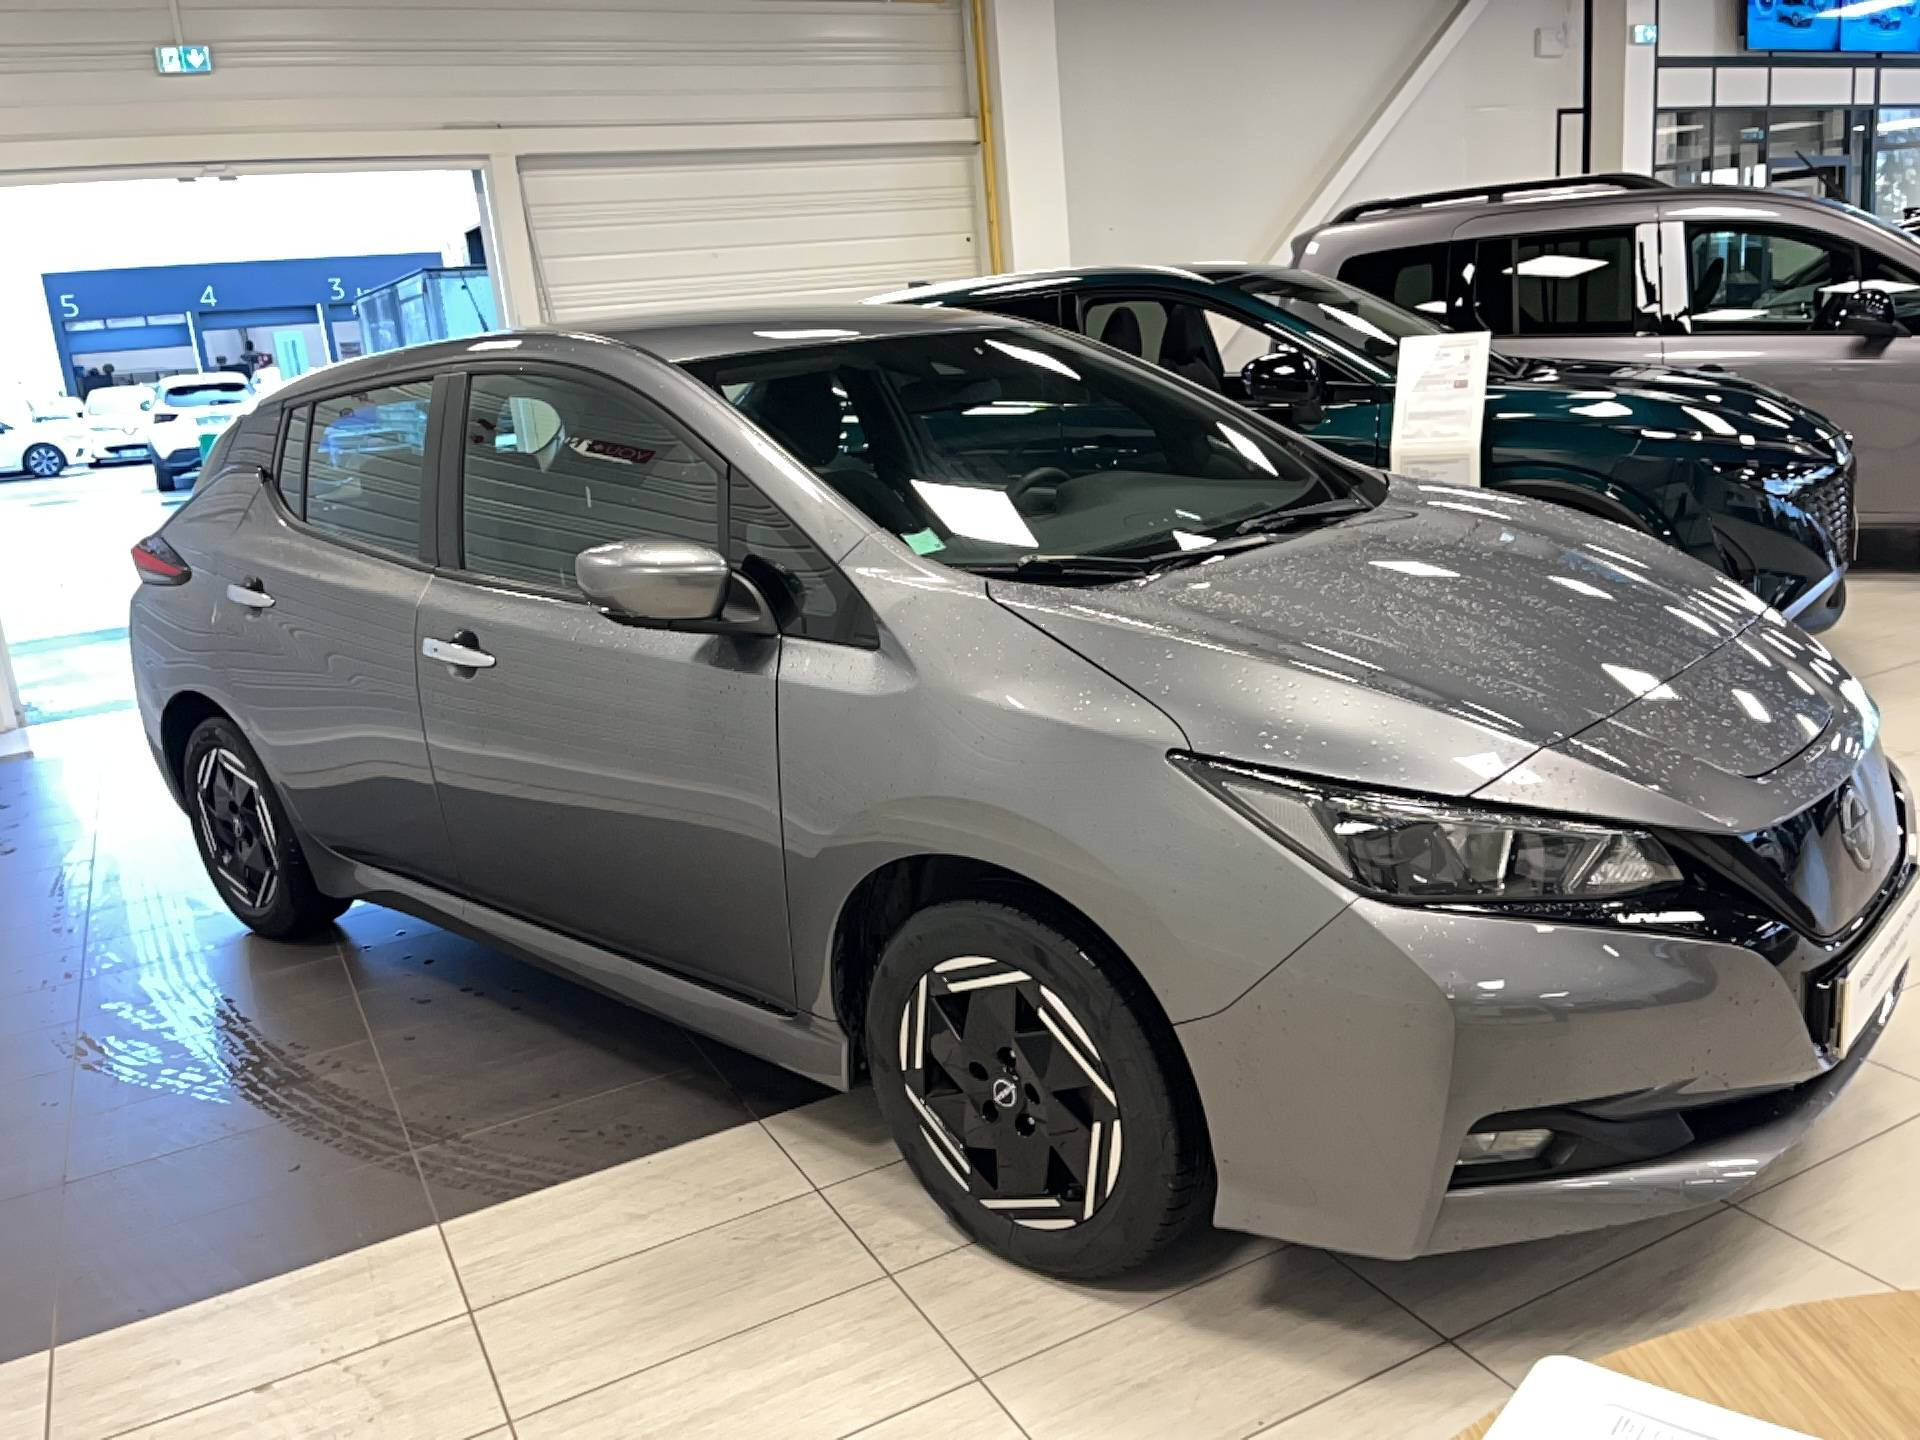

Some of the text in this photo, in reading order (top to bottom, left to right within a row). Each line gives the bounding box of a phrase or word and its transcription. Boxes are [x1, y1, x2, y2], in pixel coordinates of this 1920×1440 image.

[200, 285, 217, 306] 4
[328, 278, 345, 300] 3
[60, 294, 79, 317] 5
